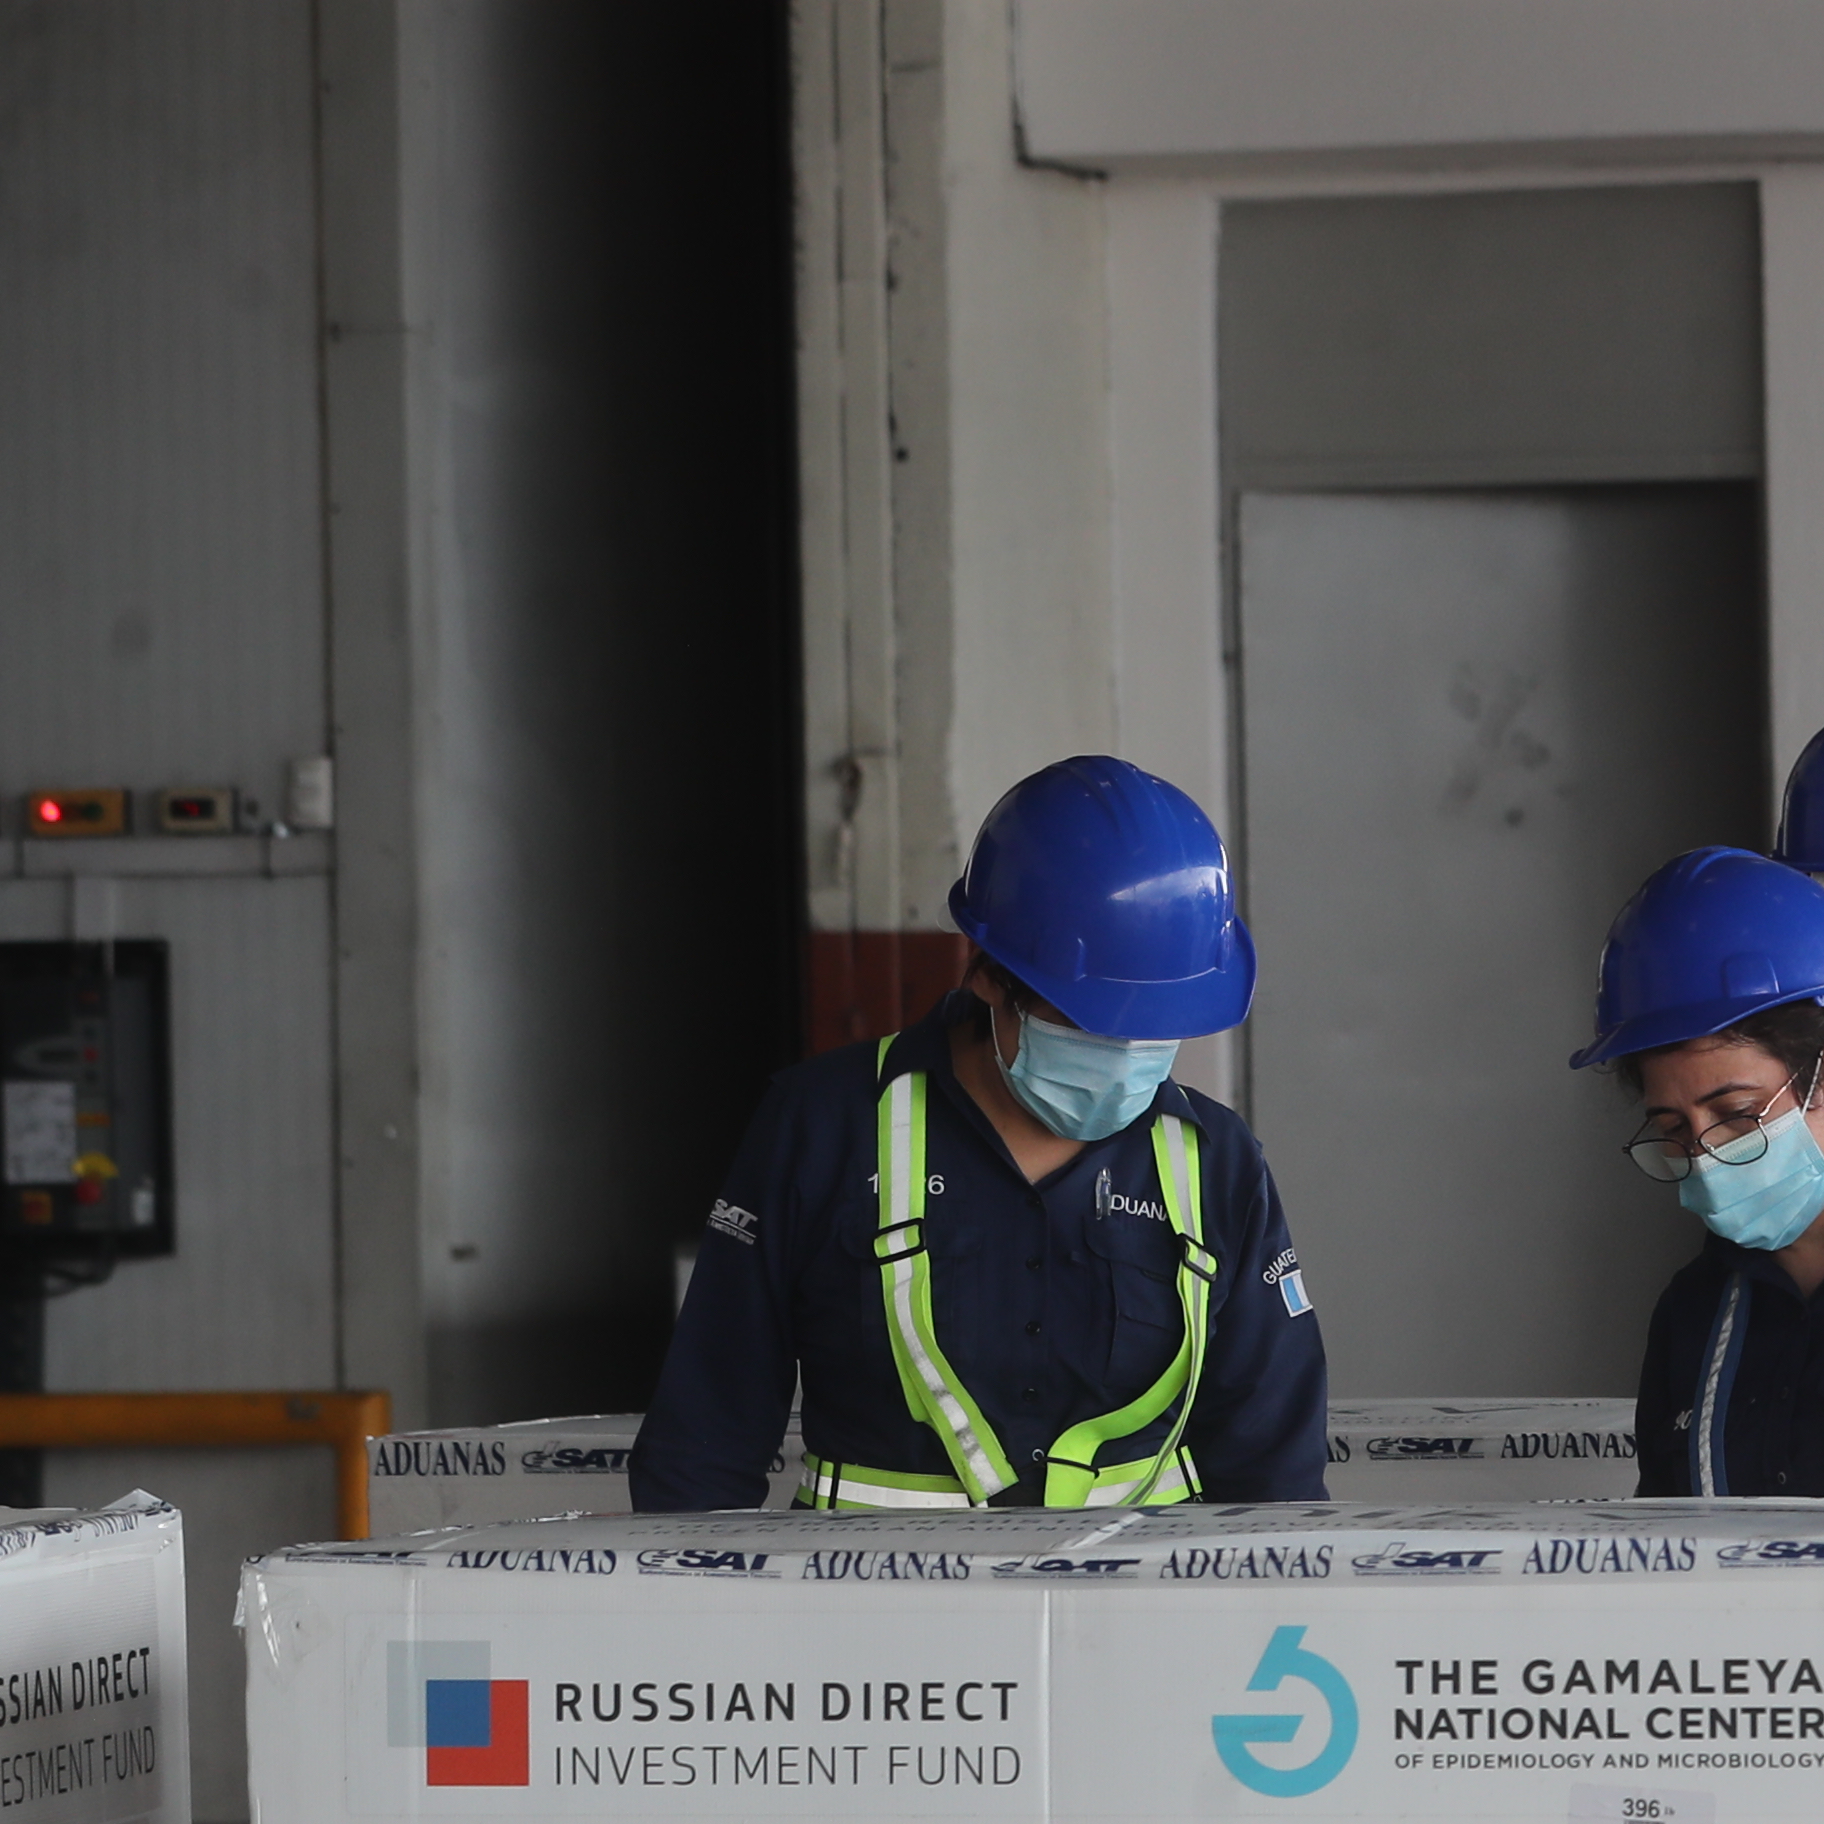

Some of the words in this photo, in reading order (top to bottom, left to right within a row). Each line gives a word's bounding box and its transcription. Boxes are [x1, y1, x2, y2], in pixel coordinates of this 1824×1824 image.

[1110, 1193, 1168, 1222] DUAN
[374, 1440, 506, 1477] ADUANAS
[1501, 1432, 1638, 1460] ADUANAS
[800, 1550, 973, 1581] ADUANAS
[1160, 1545, 1333, 1580] ADUANAS
[1521, 1536, 1697, 1575] ADUANAS
[72, 1647, 150, 1711] DIRECT
[1396, 1660, 1498, 1695] THE
[1522, 1659, 1823, 1694] GAMALEYA
[556, 1683, 794, 1722] RUSSIAN
[822, 1682, 1018, 1721] DIRECT
[1395, 1708, 1630, 1740] NATIONAL
[1646, 1708, 1824, 1739] CENTER
[0, 1738, 95, 1804] ESTMENT
[102, 1726, 155, 1783] FUND
[556, 1746, 868, 1785] INVESTMENT
[890, 1746, 1020, 1785] FUND
[1395, 1754, 1424, 1769] OF
[1432, 1754, 1594, 1769] EPIDEMIOLOGY
[1603, 1754, 1649, 1768] AND
[1622, 1797, 1661, 1819] 396
